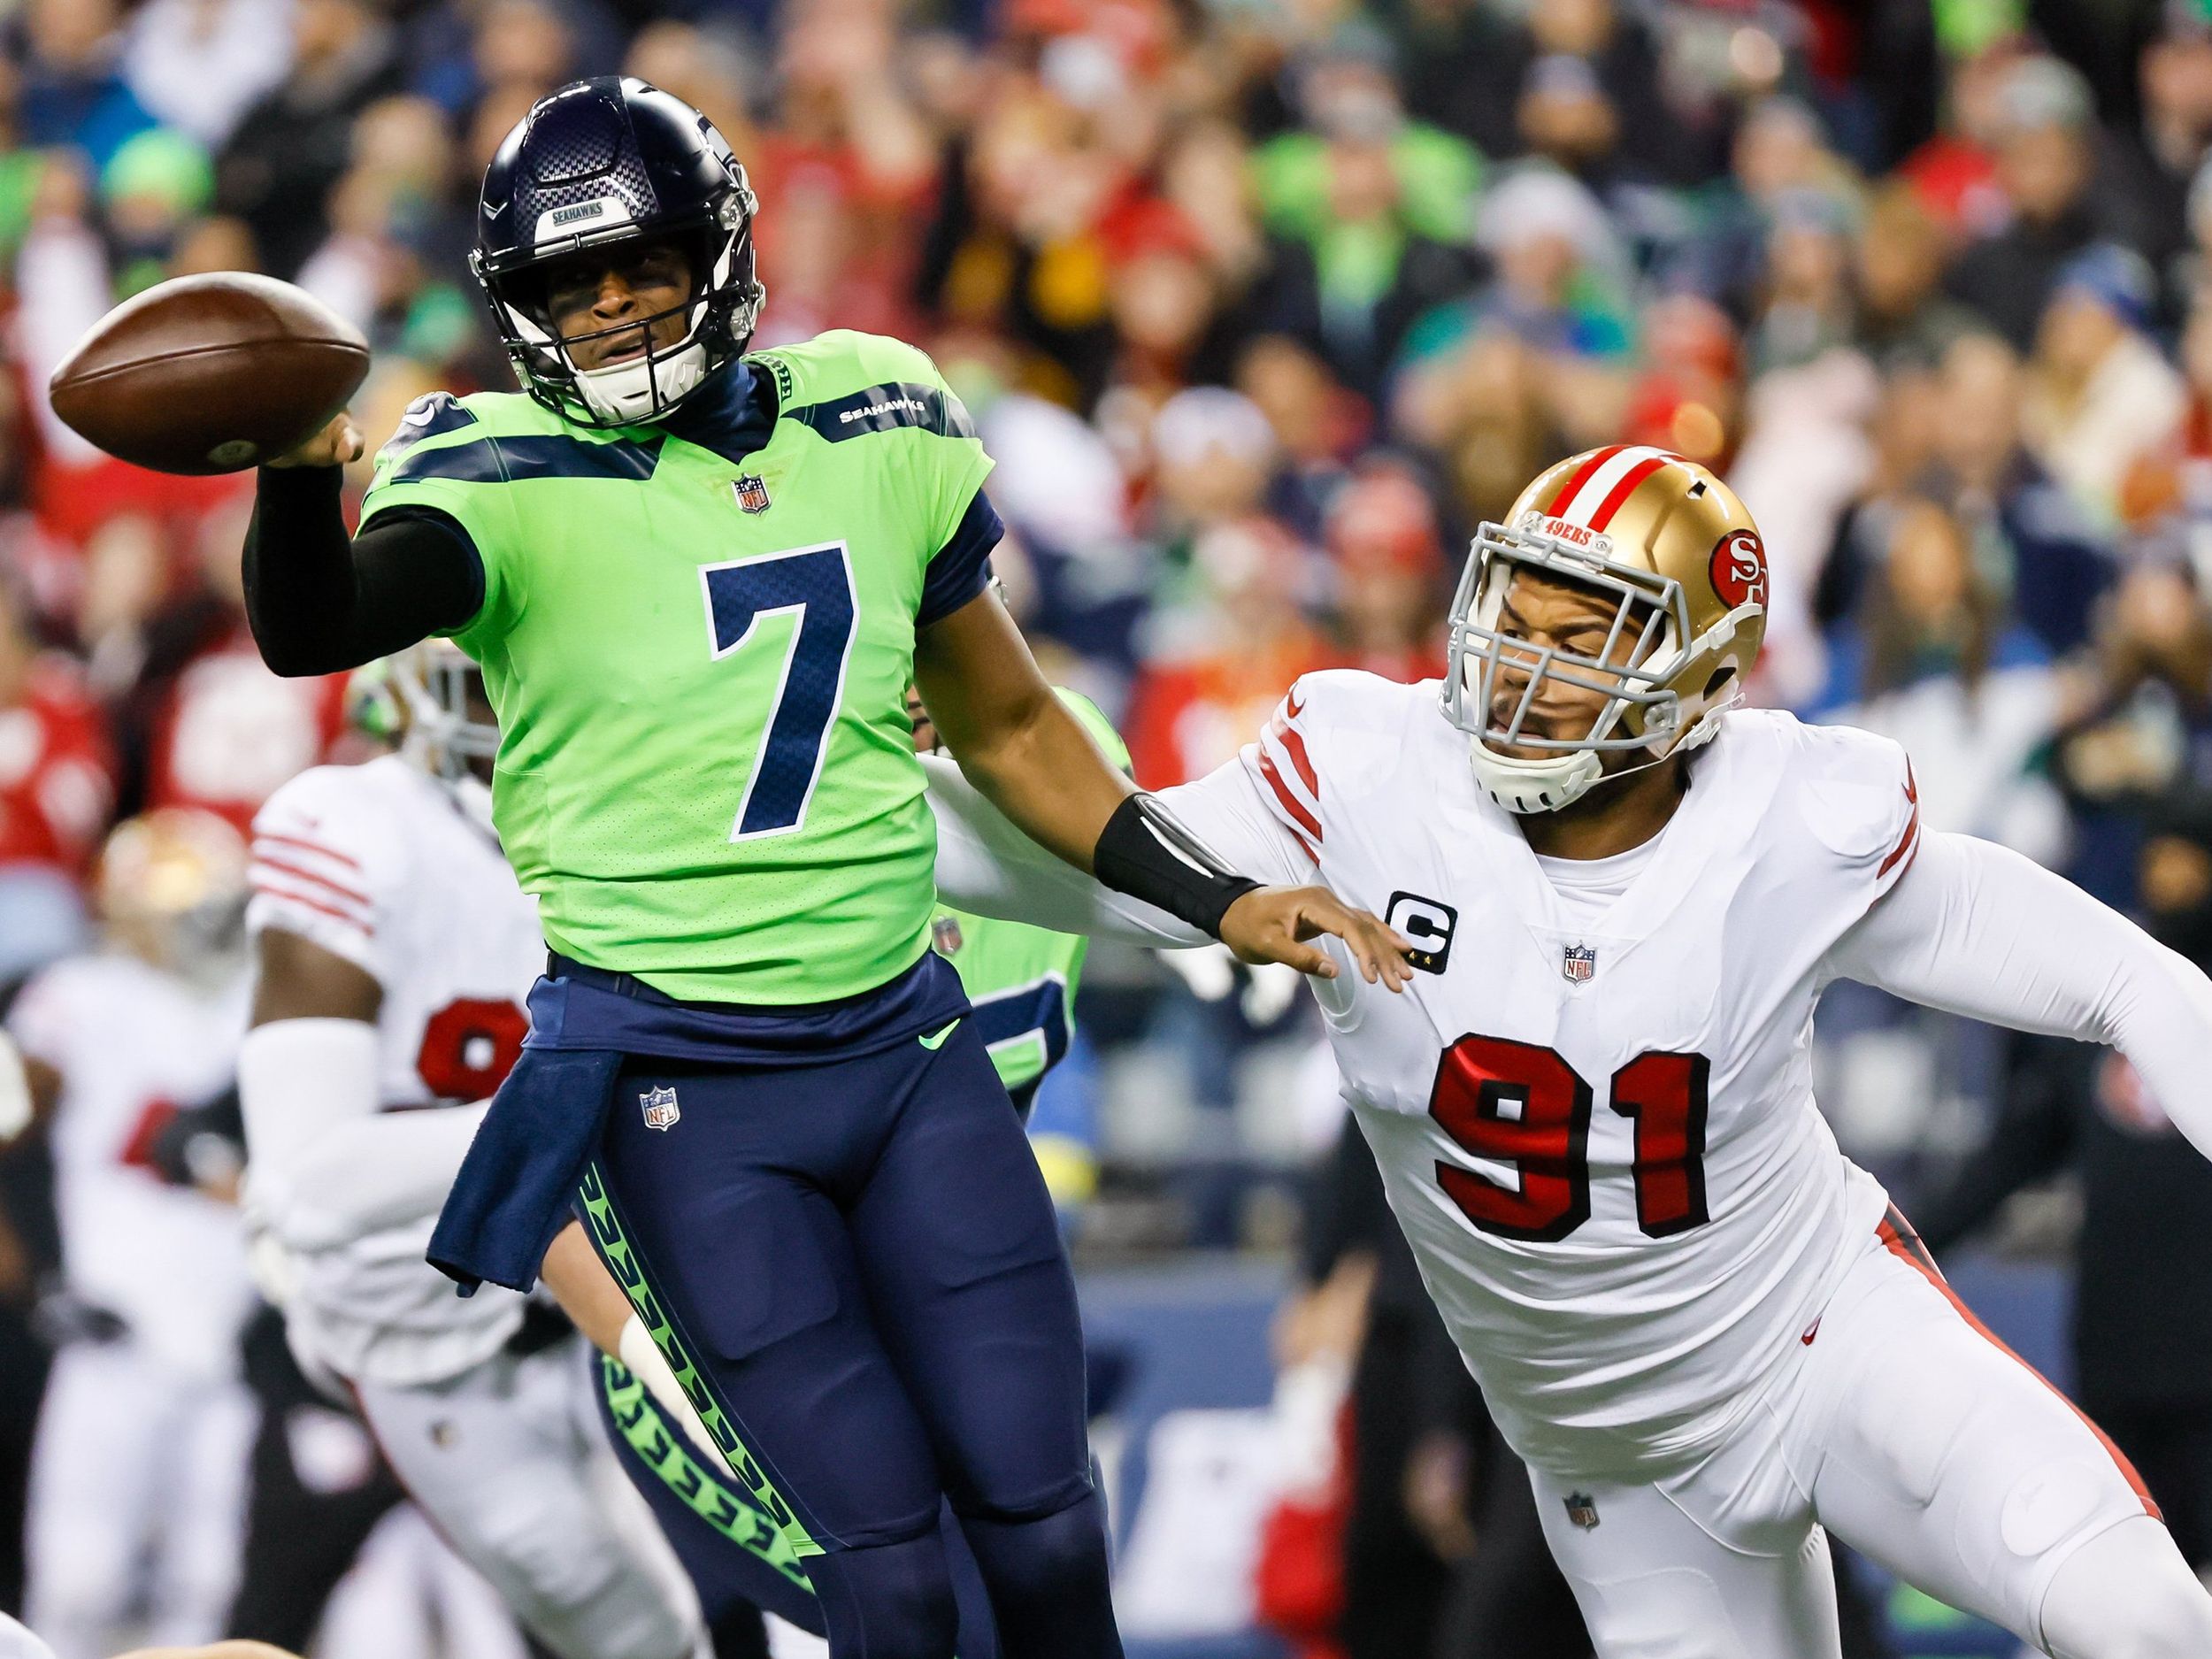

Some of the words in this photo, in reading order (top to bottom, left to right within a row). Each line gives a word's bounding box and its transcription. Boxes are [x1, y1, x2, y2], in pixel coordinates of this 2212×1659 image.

[552, 201, 603, 225] SEAHAWKS
[839, 398, 926, 424] SEAHAWKS
[741, 490, 766, 508] NFL
[1545, 519, 1593, 547] 49ERS
[697, 538, 860, 843] 7
[1389, 898, 1450, 954] C
[1566, 958, 1592, 977] NFL
[648, 1105, 674, 1125] NFL
[1428, 1032, 1711, 1242] 91
